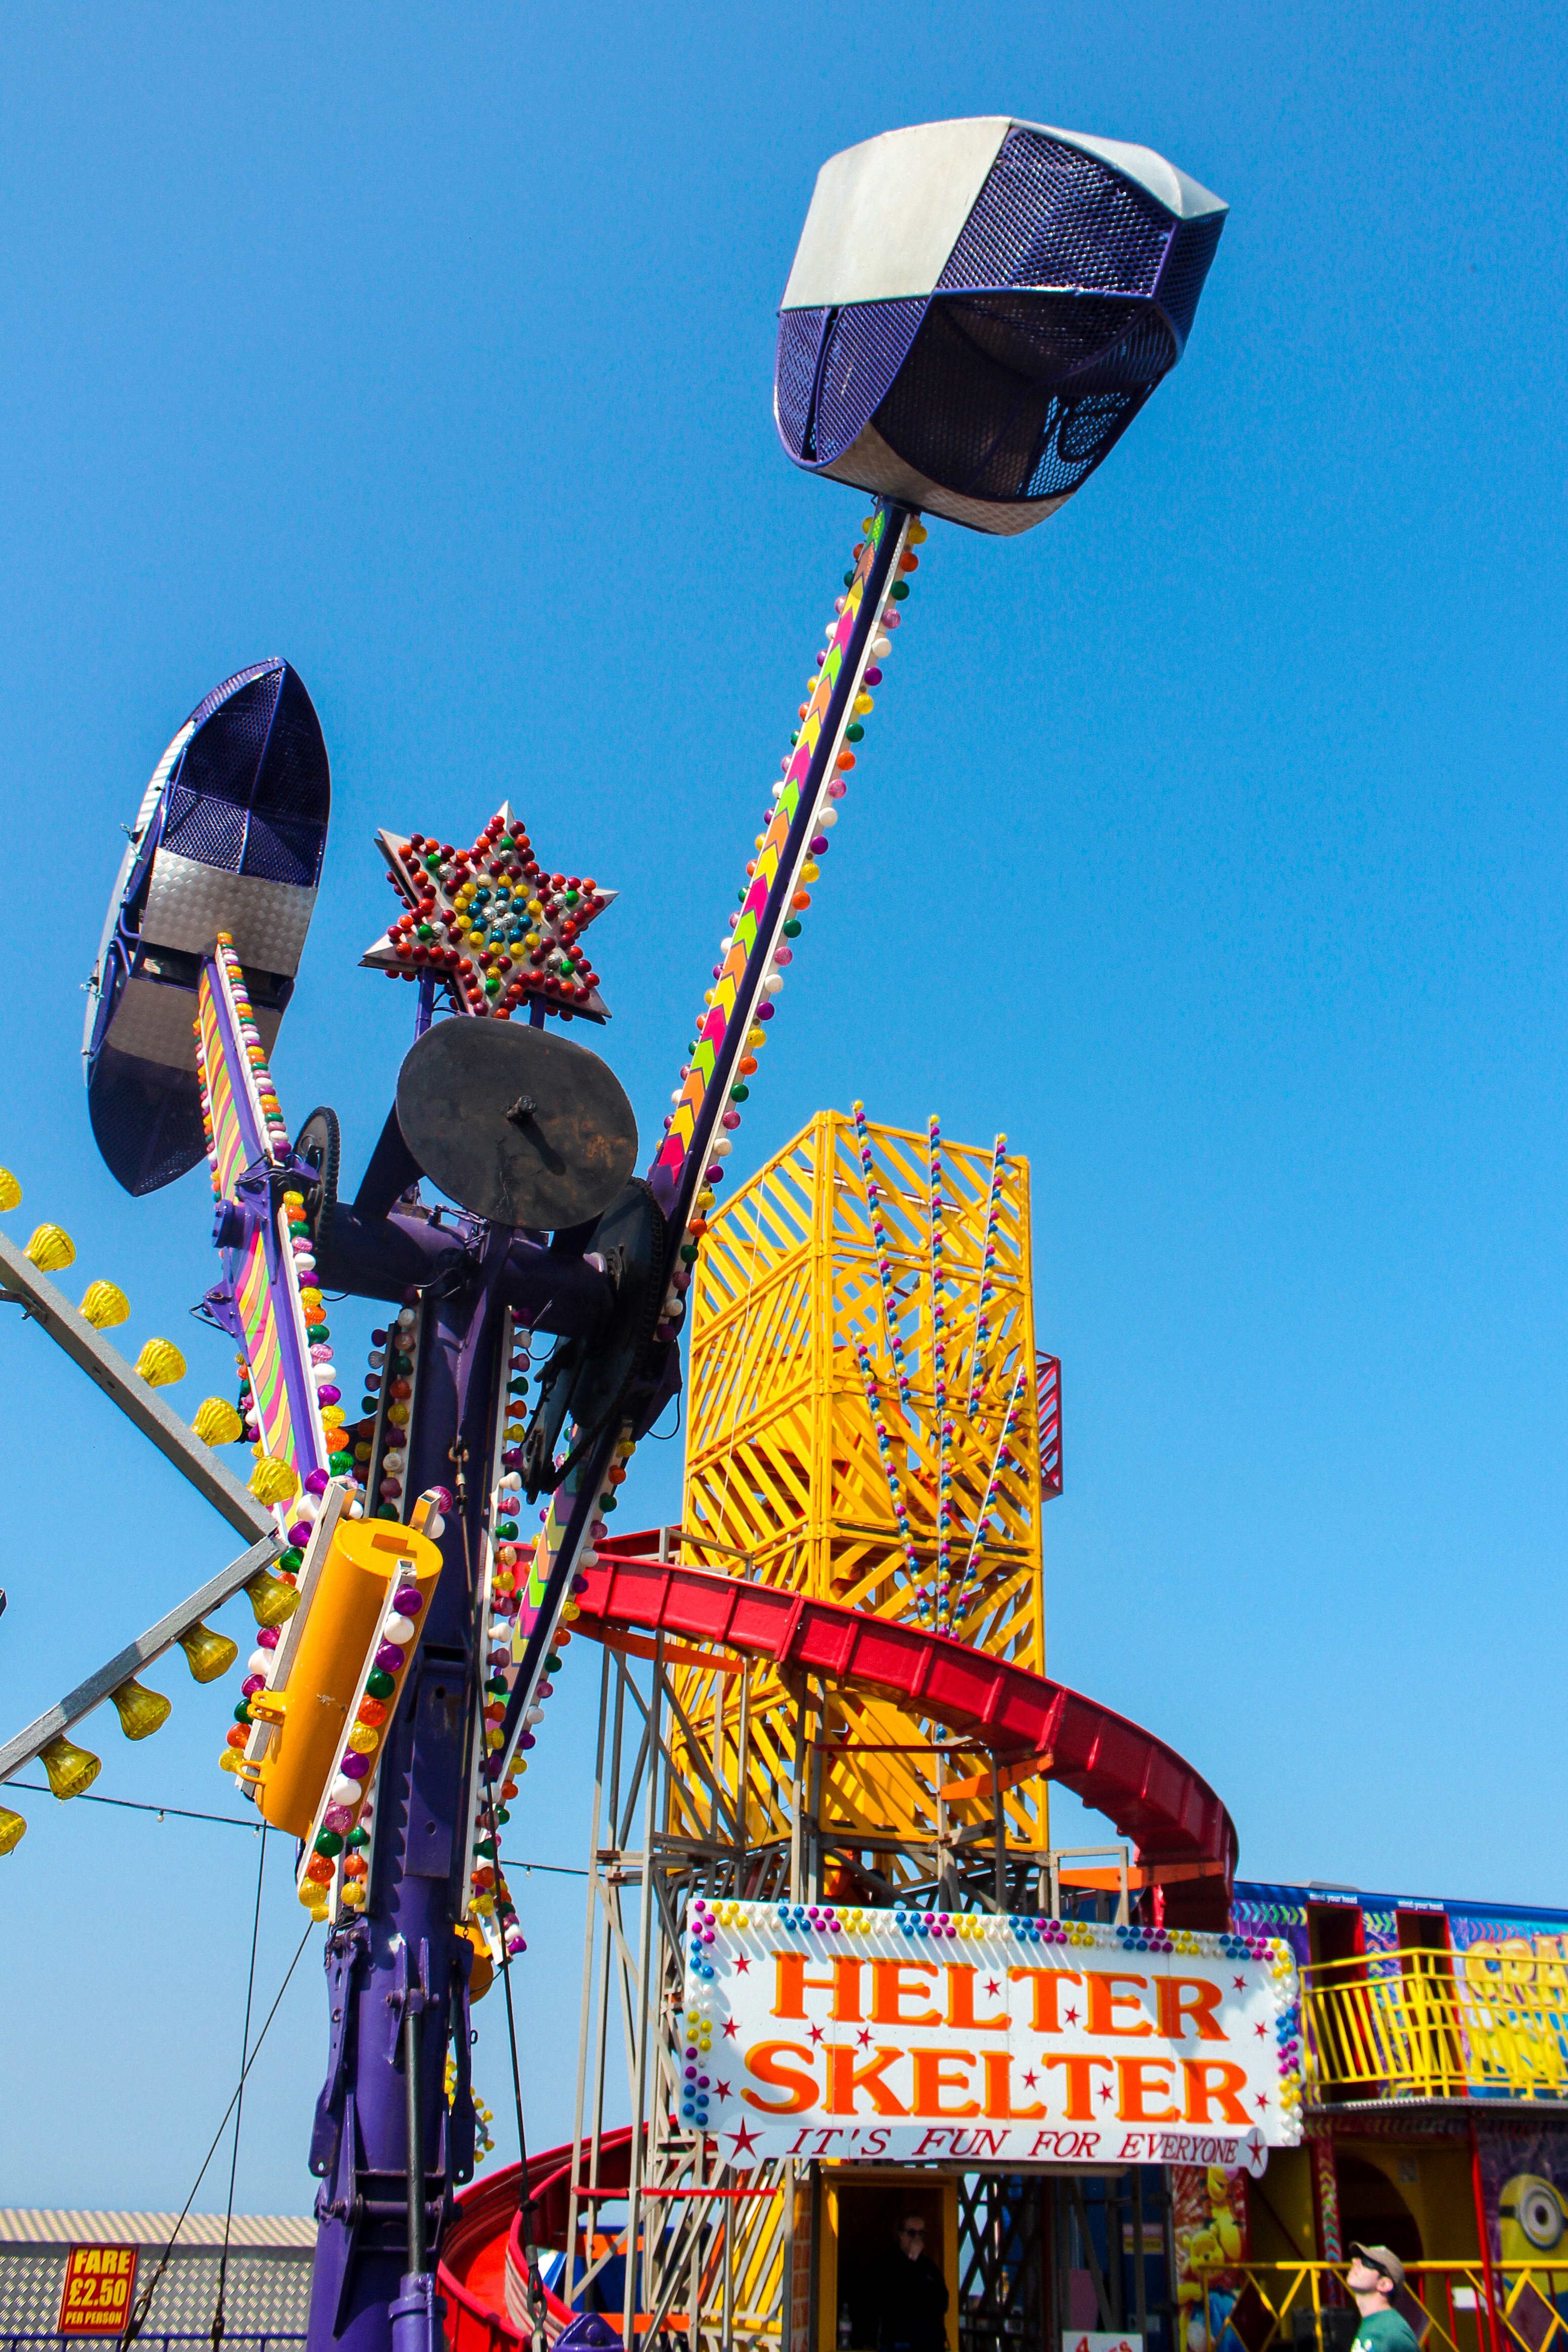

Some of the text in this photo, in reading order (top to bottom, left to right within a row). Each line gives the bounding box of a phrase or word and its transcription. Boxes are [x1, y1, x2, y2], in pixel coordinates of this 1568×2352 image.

[769, 1950, 1229, 2040] HELTER
[740, 2040, 1254, 2125] SKELTER
[787, 2127, 1238, 2163] IT'S FUN FOR EVERYONE
[73, 2249, 131, 2274] FARE
[67, 2277, 127, 2307] £2.50
[65, 2311, 123, 2325] PER PERSON
